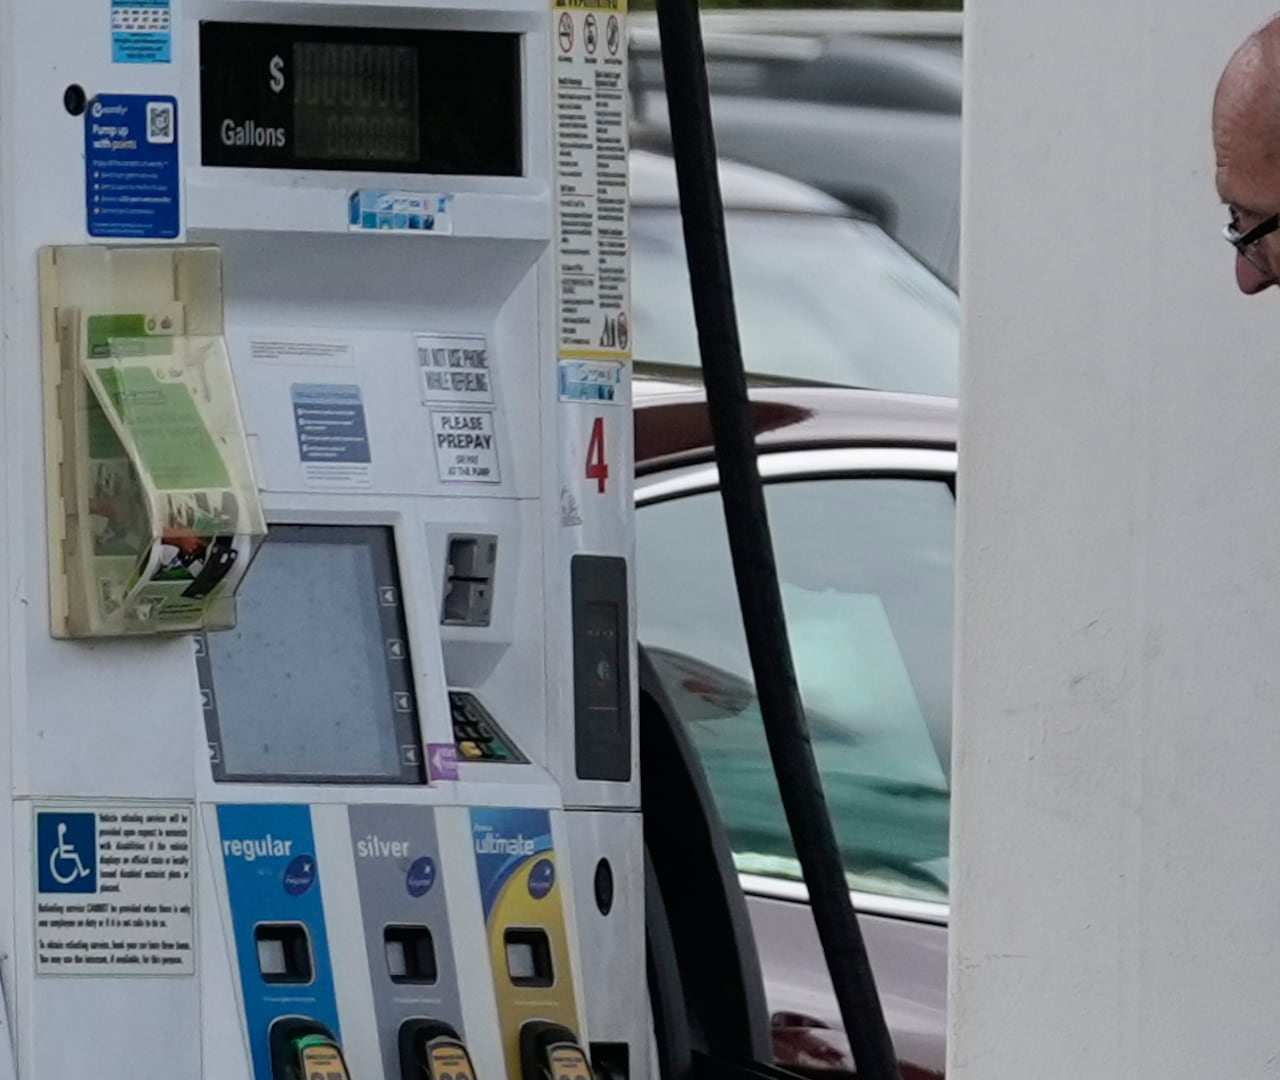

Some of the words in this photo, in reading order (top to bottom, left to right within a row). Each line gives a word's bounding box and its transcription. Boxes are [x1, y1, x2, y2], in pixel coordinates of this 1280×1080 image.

[270, 55, 285, 93] $
[221, 119, 286, 147] Gallons
[441, 416, 483, 431] PLEASE
[437, 433, 492, 450] PREPAY
[586, 417, 609, 493] 4
[223, 833, 293, 862] regular
[357, 834, 410, 857] silver
[475, 832, 535, 855] ultimate
